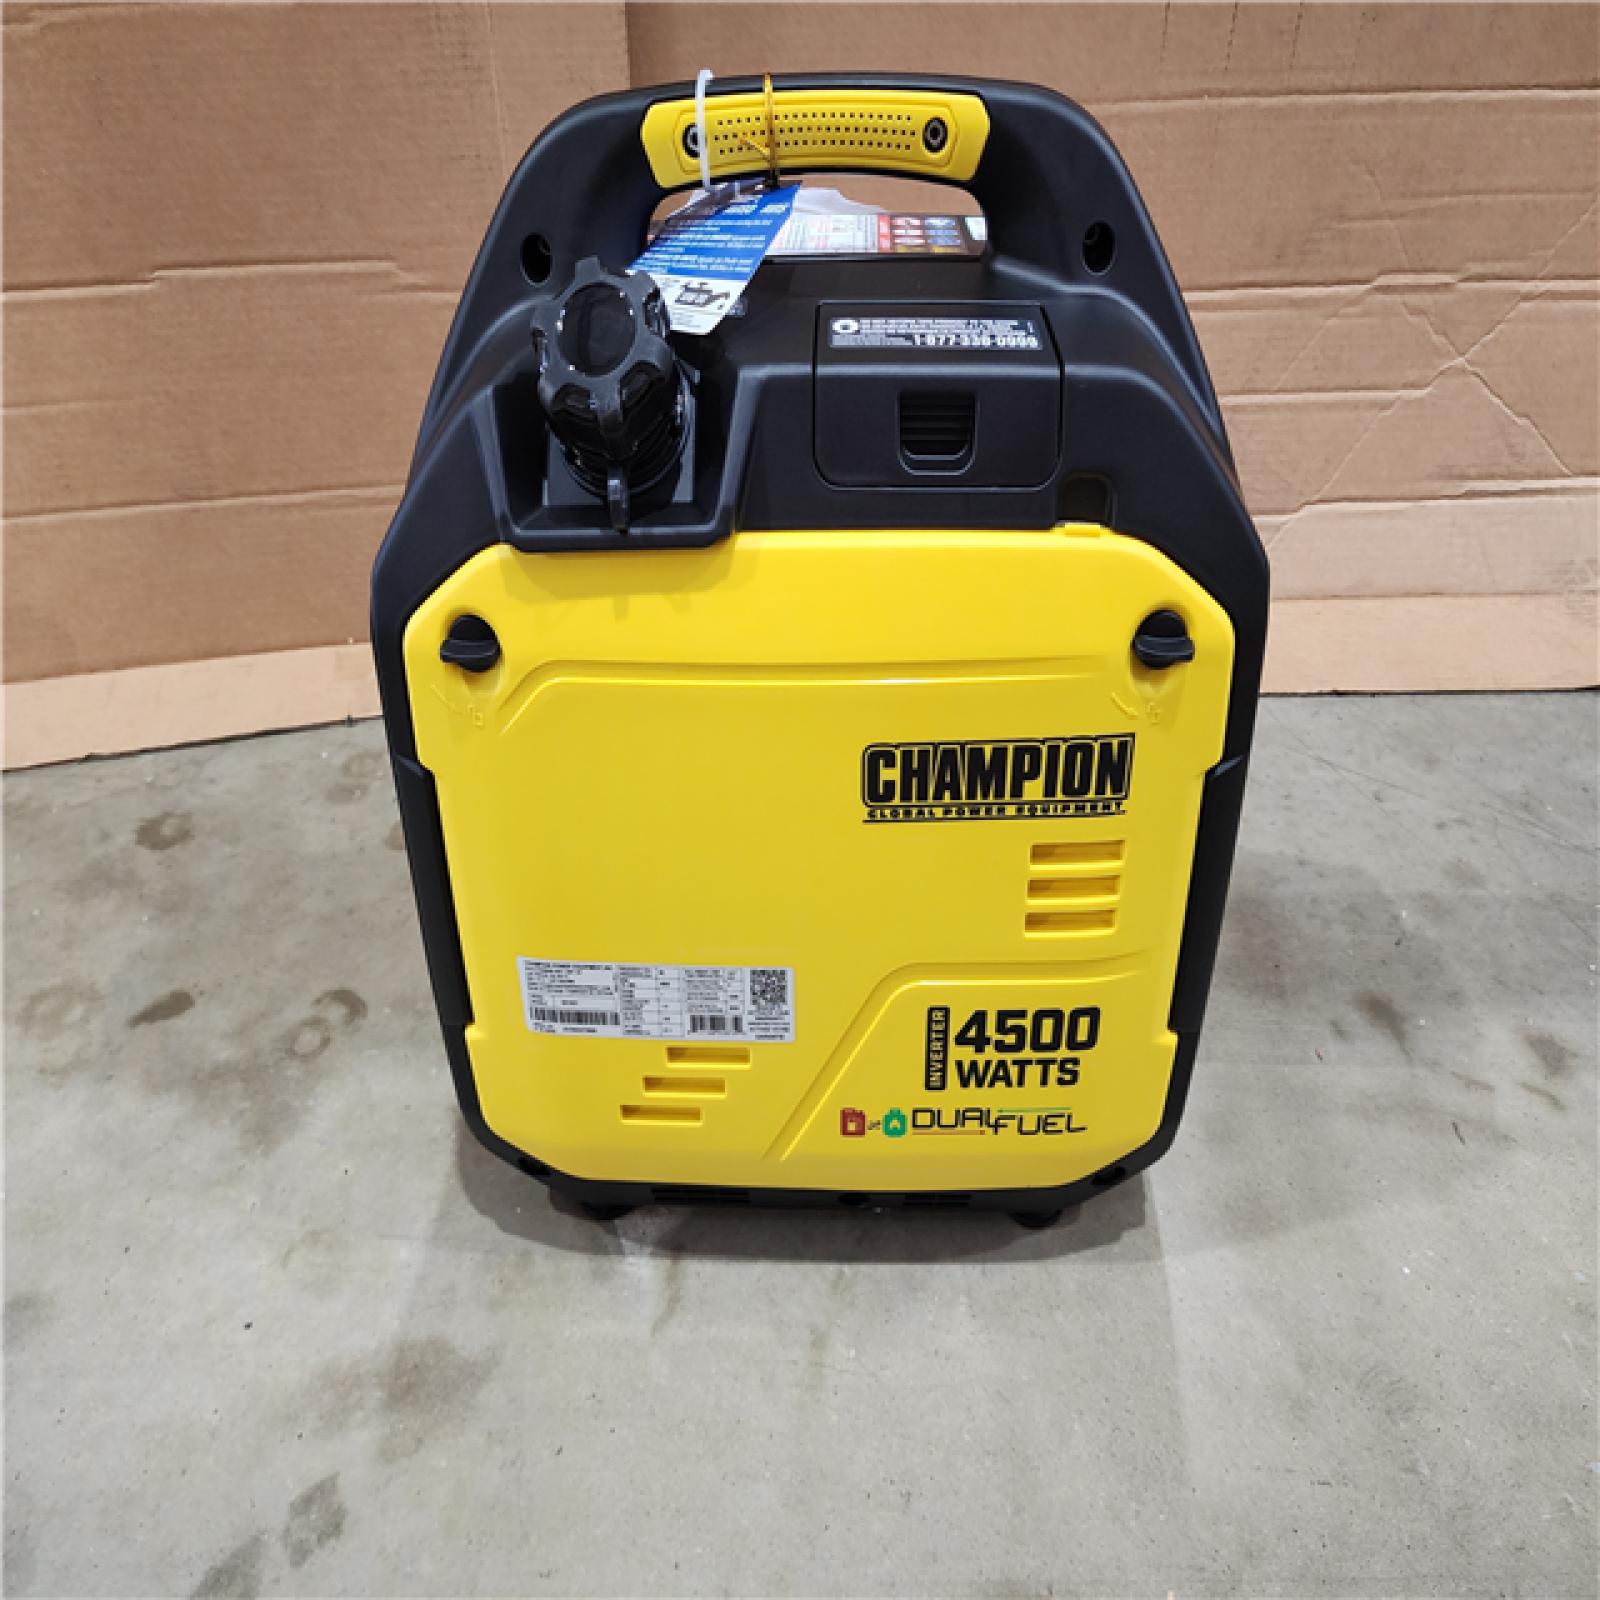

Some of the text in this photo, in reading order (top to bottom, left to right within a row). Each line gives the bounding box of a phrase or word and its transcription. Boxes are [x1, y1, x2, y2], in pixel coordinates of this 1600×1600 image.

[866, 739, 1130, 803] CHAMPION
[868, 801, 1124, 819] GLOBAL POWER EQUIPMENT
[929, 1009, 946, 1088] INVERTER
[954, 1006, 1101, 1054] 4500
[954, 1057, 1081, 1089] WATTS
